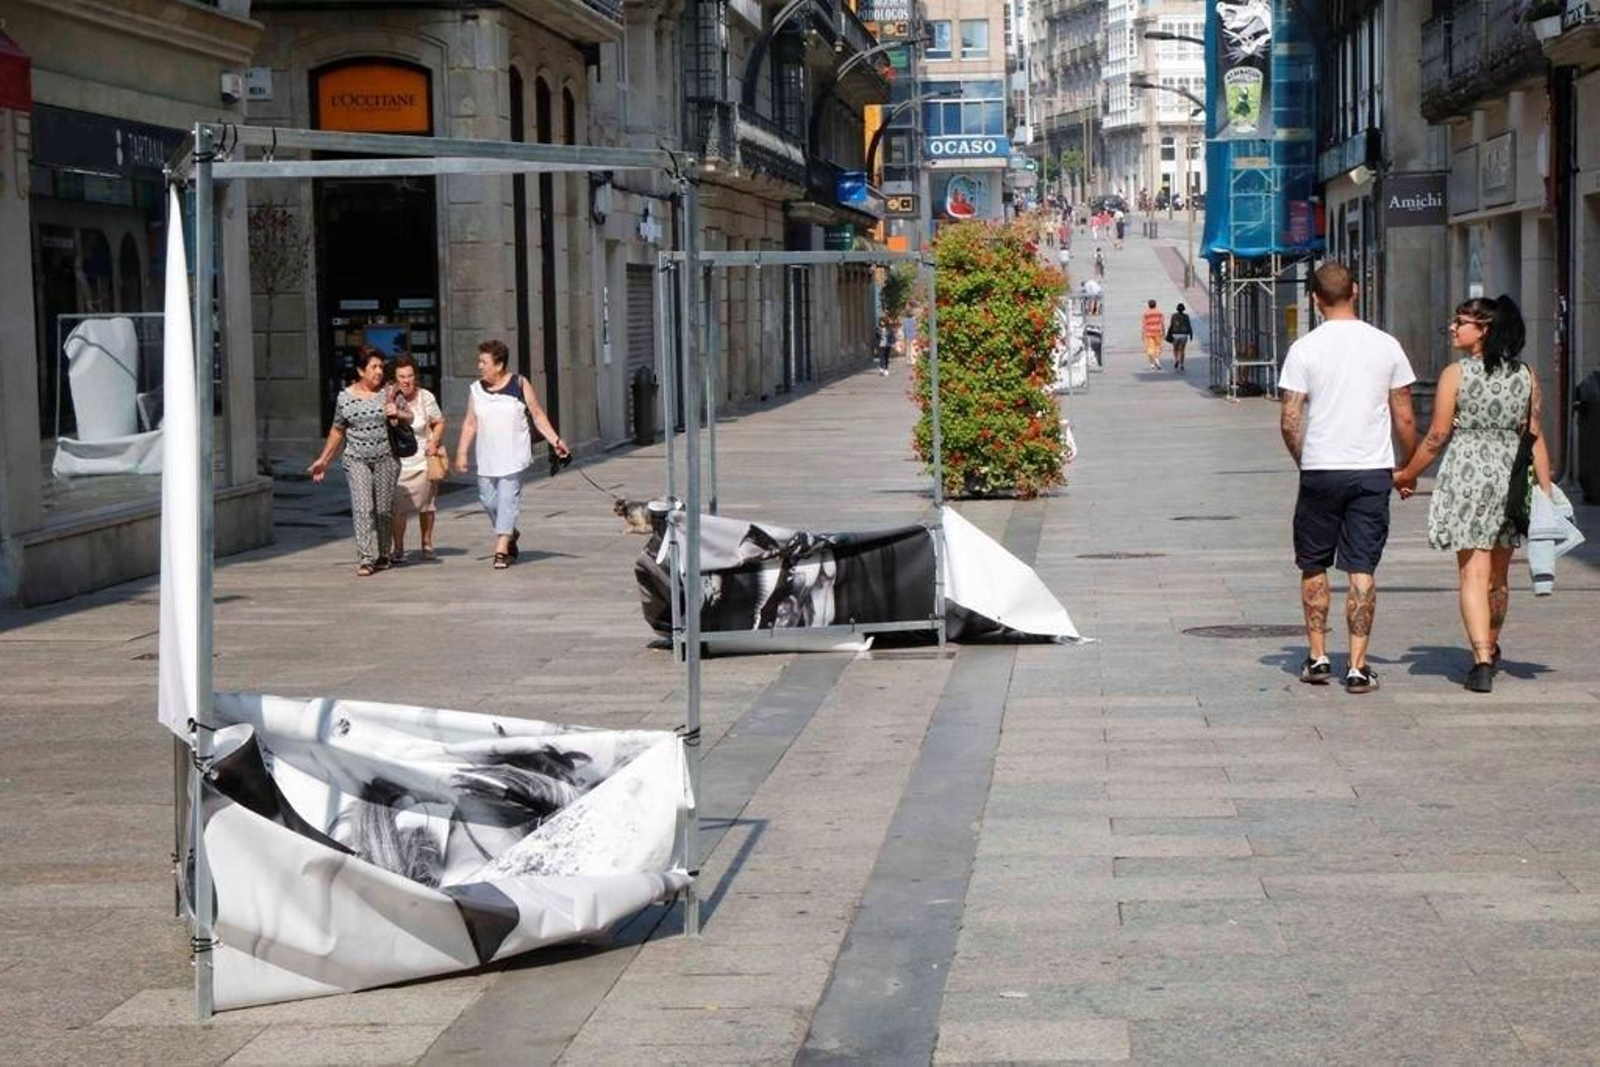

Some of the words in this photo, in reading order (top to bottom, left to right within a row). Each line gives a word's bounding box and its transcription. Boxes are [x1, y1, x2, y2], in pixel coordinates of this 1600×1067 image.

[331, 93, 416, 107] L'OCCITANE
[930, 140, 996, 154] OCASO
[1388, 192, 1442, 209] Amichi
